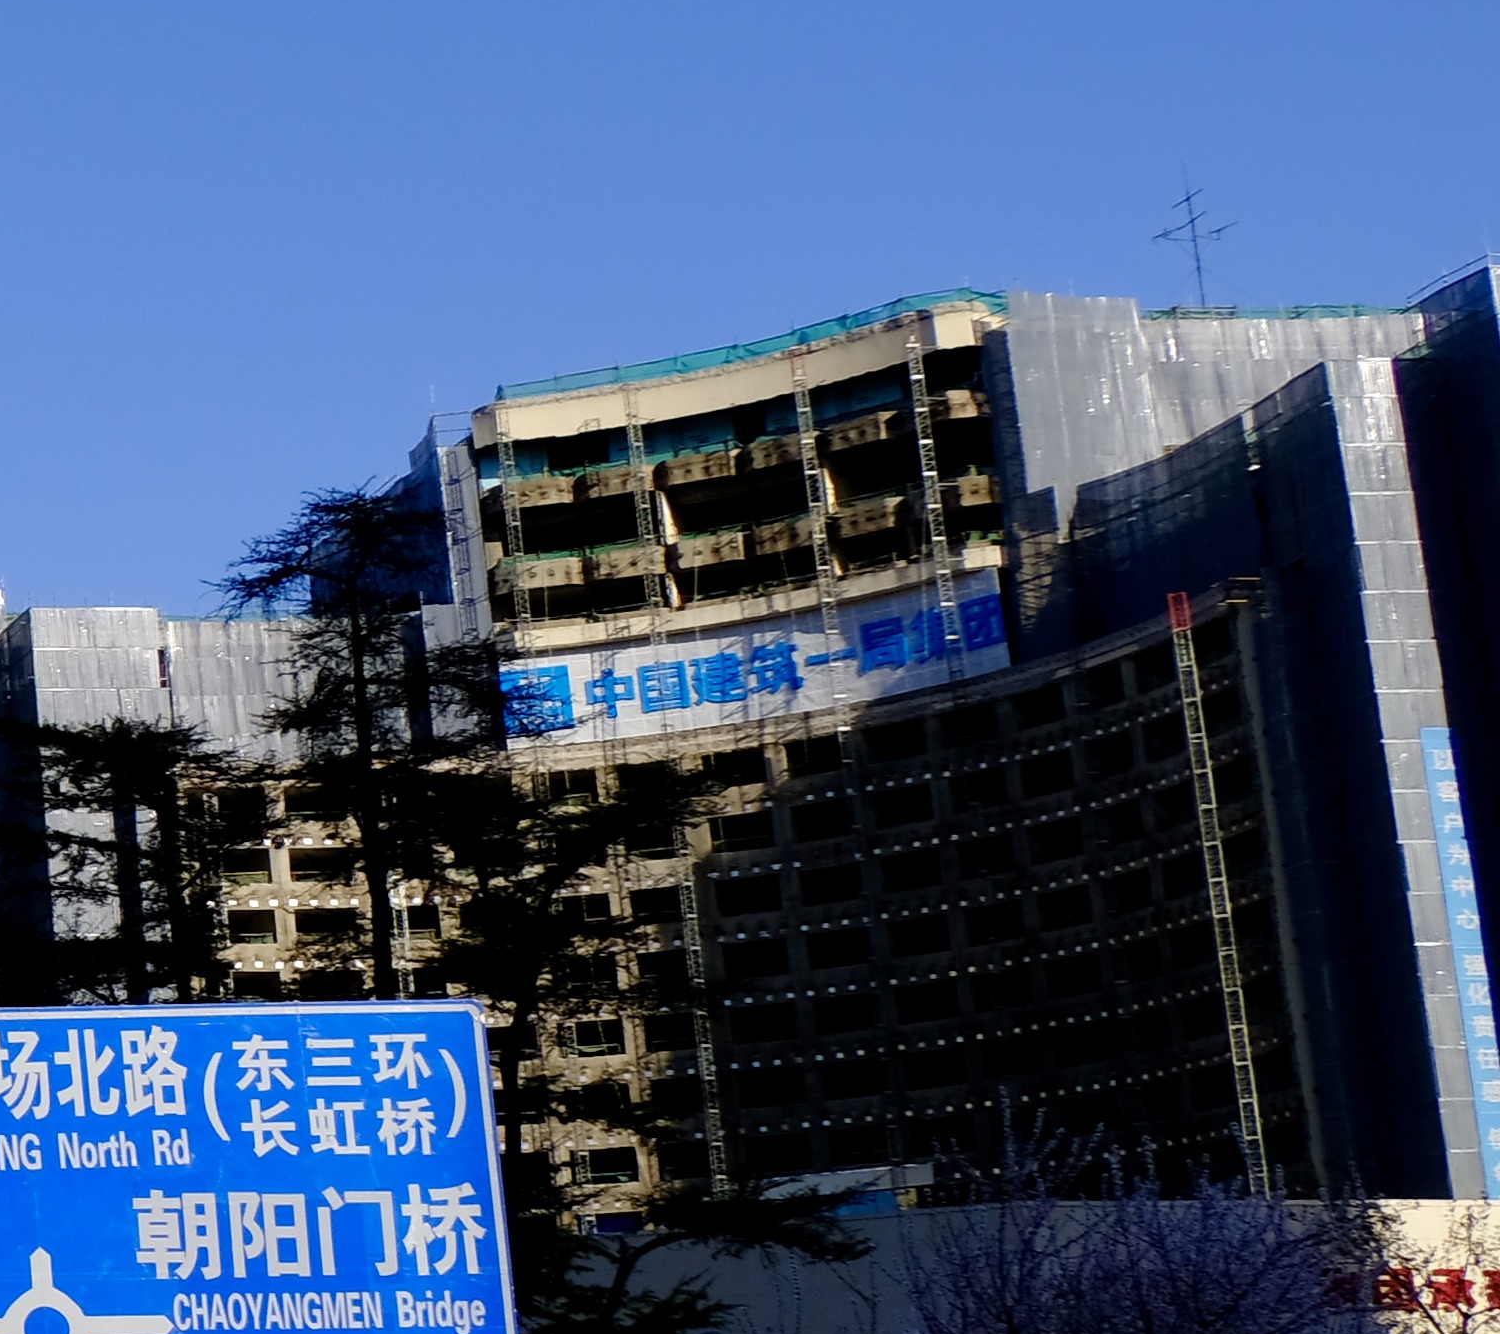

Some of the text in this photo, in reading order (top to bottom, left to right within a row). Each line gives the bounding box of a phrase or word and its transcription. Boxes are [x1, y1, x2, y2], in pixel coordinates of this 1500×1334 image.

[584, 592, 1007, 719] 中国建筑一局集团
[57, 1129, 139, 1169] North
[152, 1127, 192, 1167] Rd
[131, 1181, 488, 1280] 朝阳门桥
[171, 1290, 385, 1333] CHAOYANGMEN
